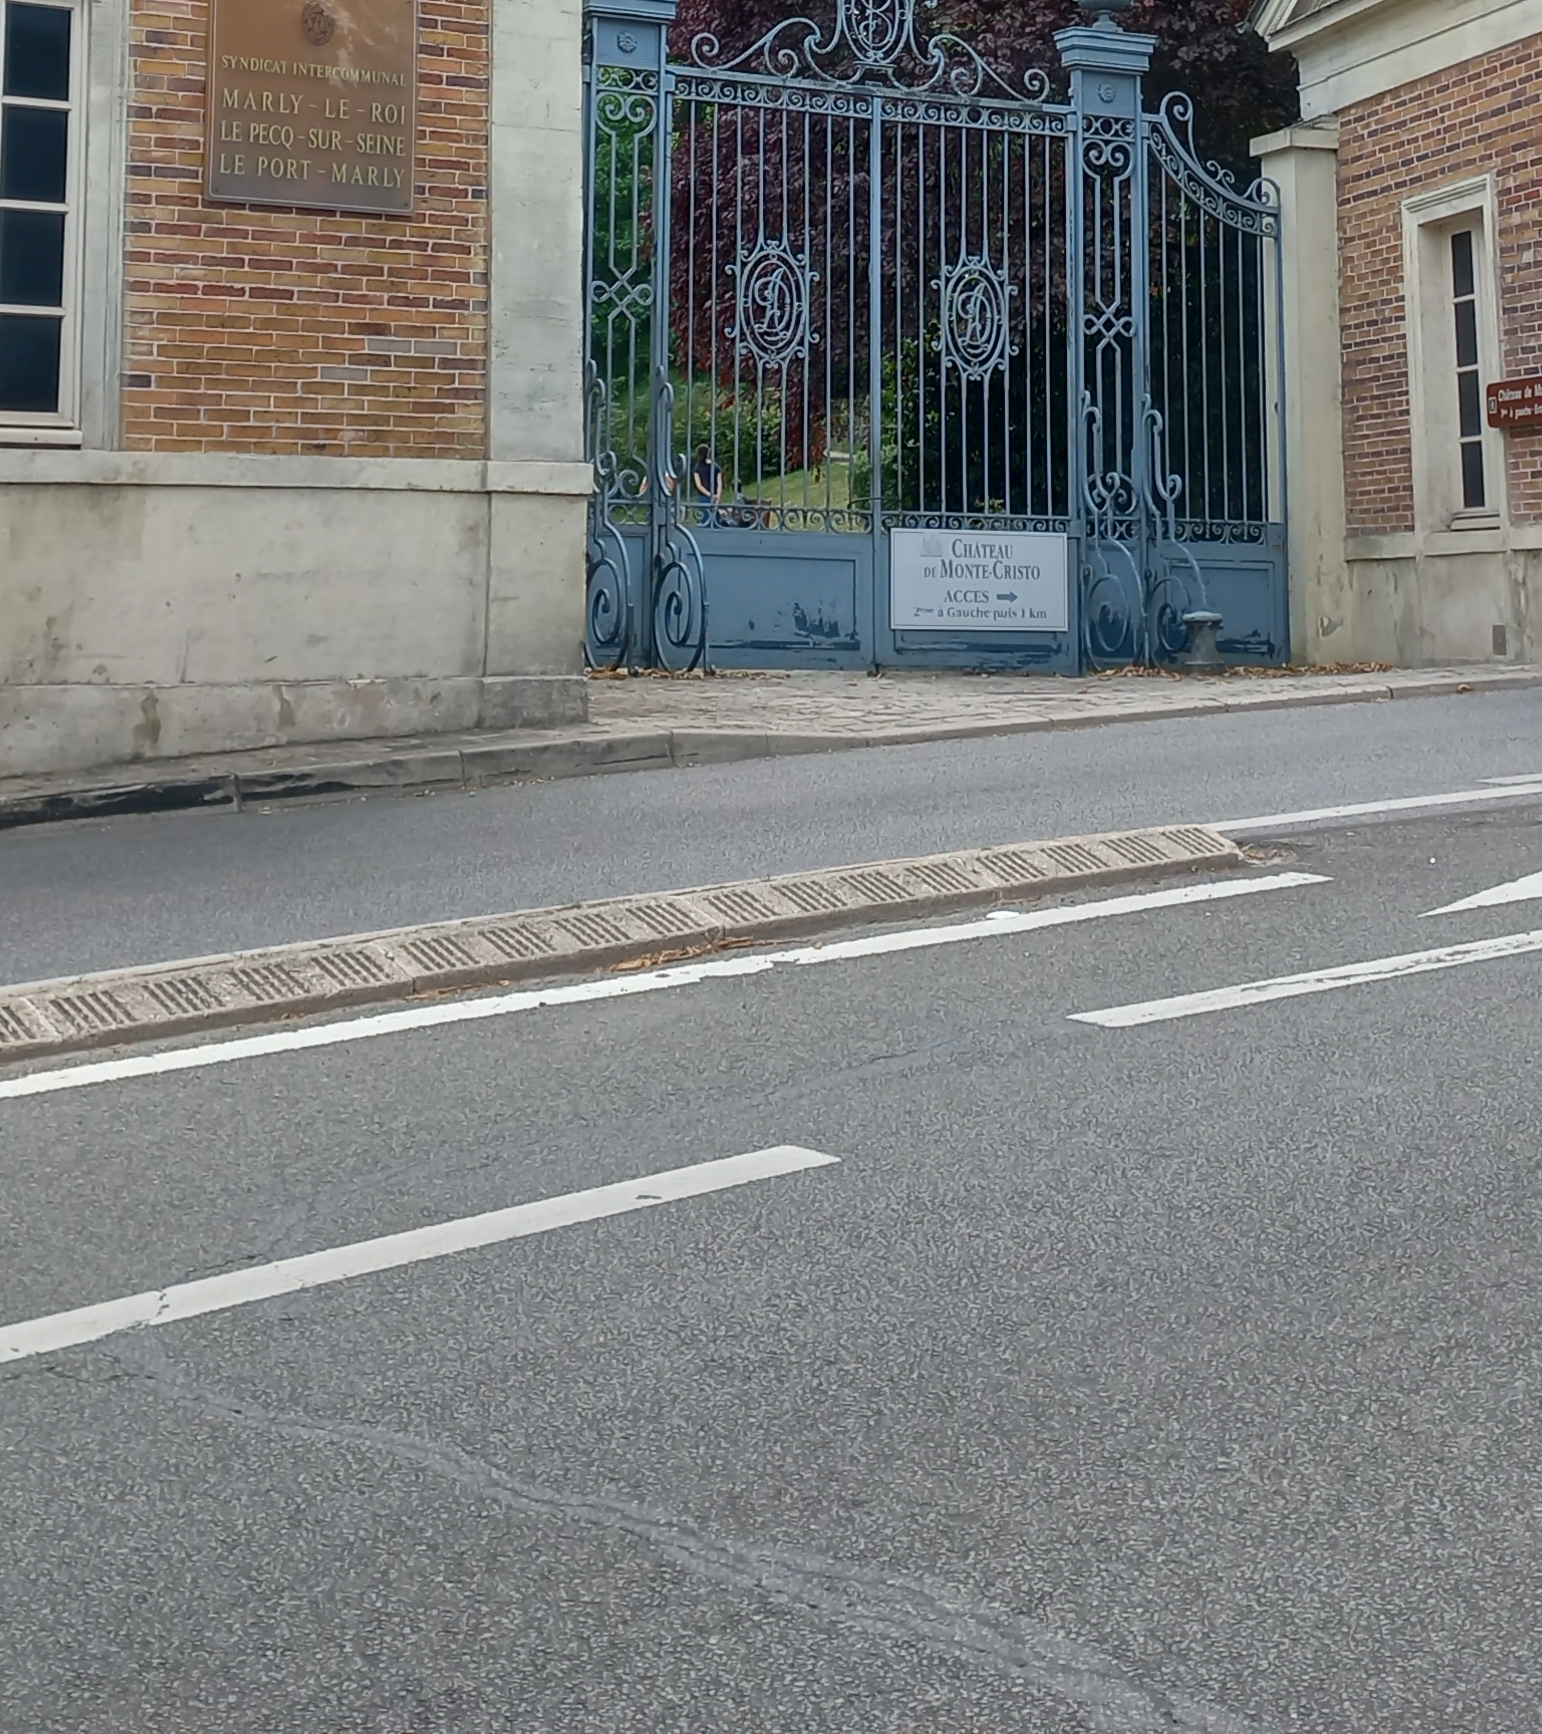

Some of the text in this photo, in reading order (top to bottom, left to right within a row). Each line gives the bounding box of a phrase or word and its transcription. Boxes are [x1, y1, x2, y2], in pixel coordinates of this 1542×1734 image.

[221, 54, 407, 87] SYNDICAT INTERCOMMUNAL
[220, 120, 243, 142] LE
[219, 153, 245, 175] LE
[924, 567, 937, 578] DE
[947, 607, 991, 618] Gauche
[1021, 608, 1026, 618] 1
[1029, 608, 1047, 618] km
